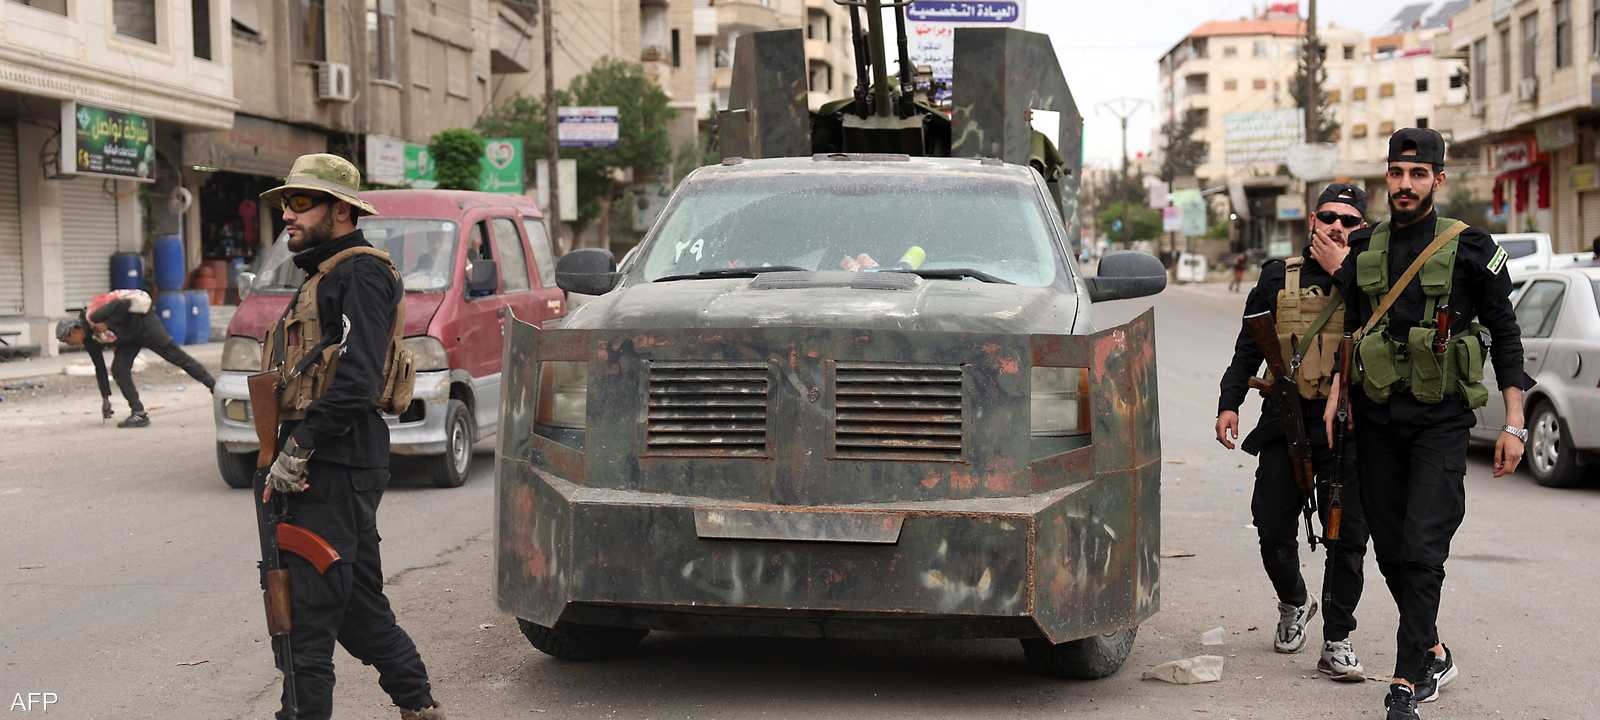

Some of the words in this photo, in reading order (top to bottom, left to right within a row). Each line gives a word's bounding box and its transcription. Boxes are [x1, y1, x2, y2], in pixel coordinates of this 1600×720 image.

[908, 3, 975, 20] التخصصية
[976, 4, 1016, 20] العيادة
[92, 112, 122, 143] تواصل
[123, 119, 149, 143] شركة
